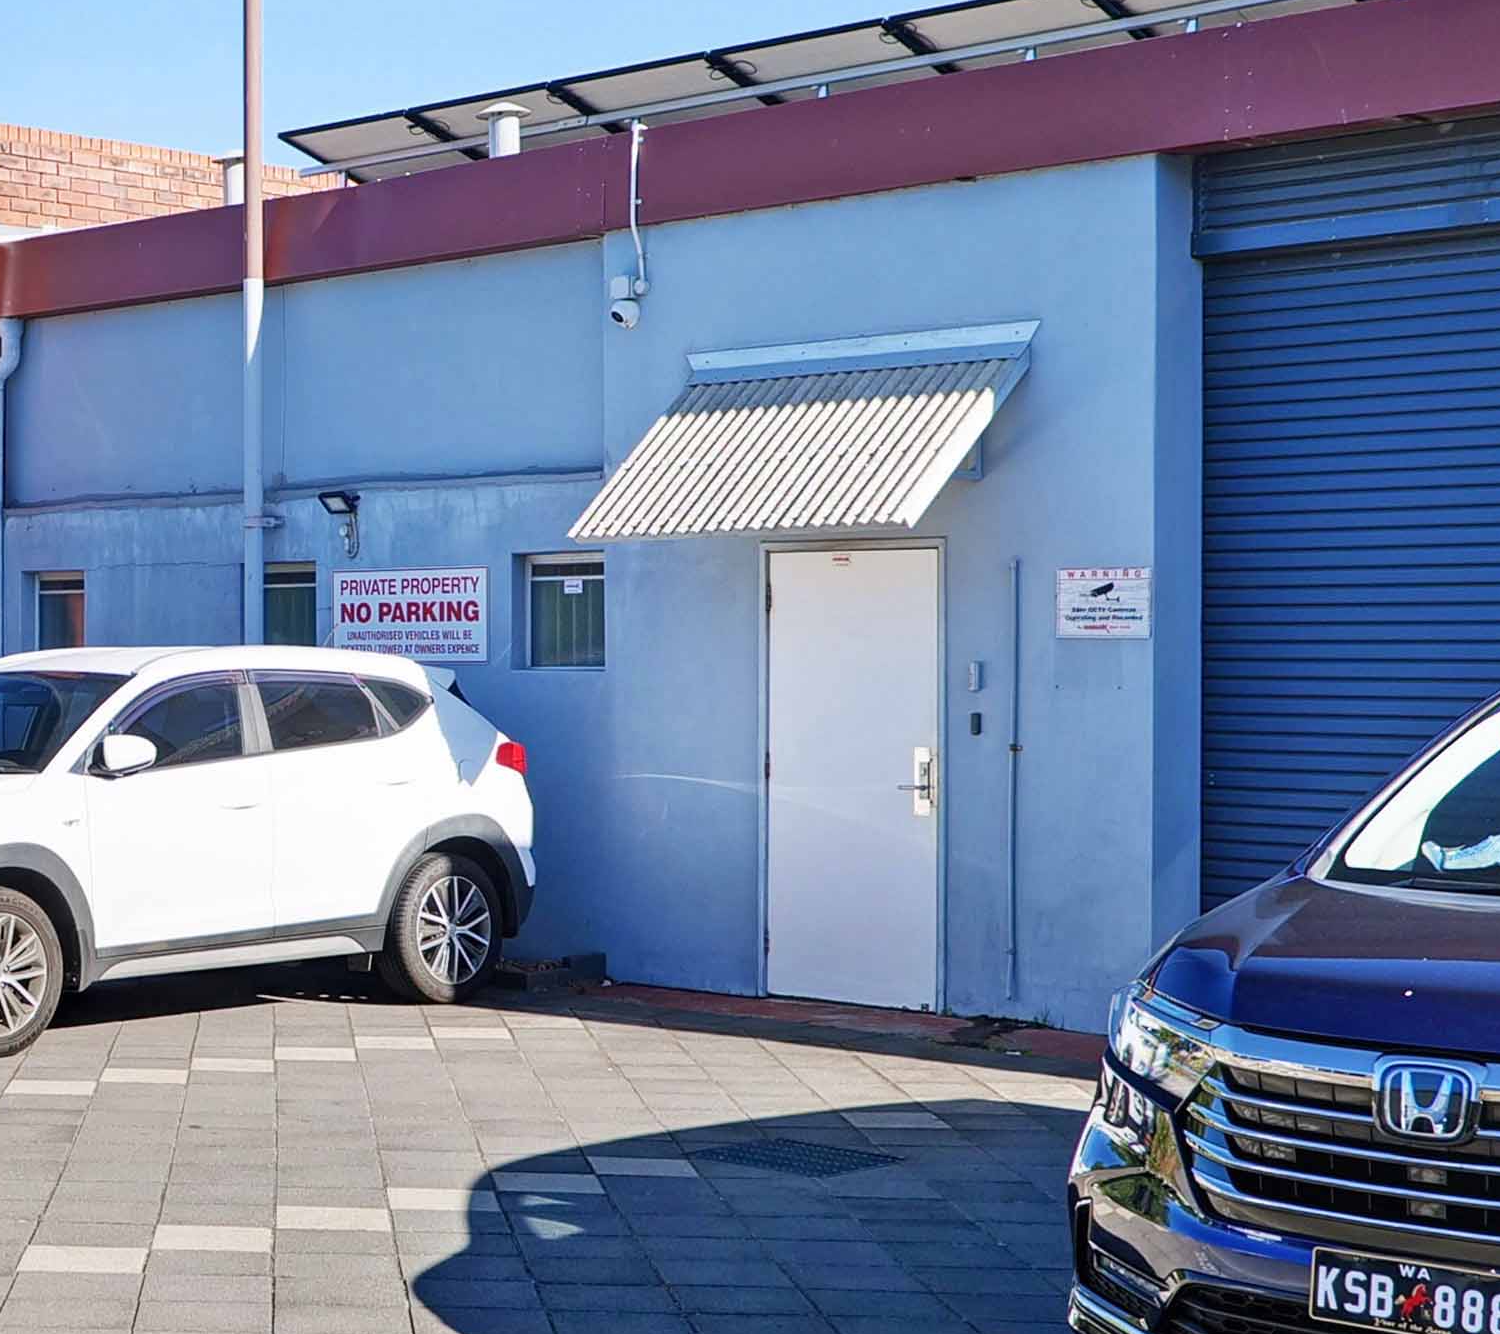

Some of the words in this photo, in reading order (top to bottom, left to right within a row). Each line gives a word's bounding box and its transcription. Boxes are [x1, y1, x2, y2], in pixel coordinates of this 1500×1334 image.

[1067, 570, 1141, 578] WARNING
[340, 579, 397, 596] PRIVATE
[401, 576, 480, 595] PROPERTY
[340, 602, 372, 623] NO
[378, 600, 480, 623] PARKING
[347, 630, 403, 641] UNAUTHORISED
[405, 629, 440, 640] VEHICLES
[442, 629, 461, 640] WILL
[463, 629, 473, 640] BE
[378, 644, 403, 654] TOWED
[404, 644, 414, 654] AT
[415, 644, 446, 654] OWNERS
[448, 643, 480, 654] EXPENCE
[1399, 1263, 1431, 1281] WA
[1316, 1264, 1394, 1318] KSB
